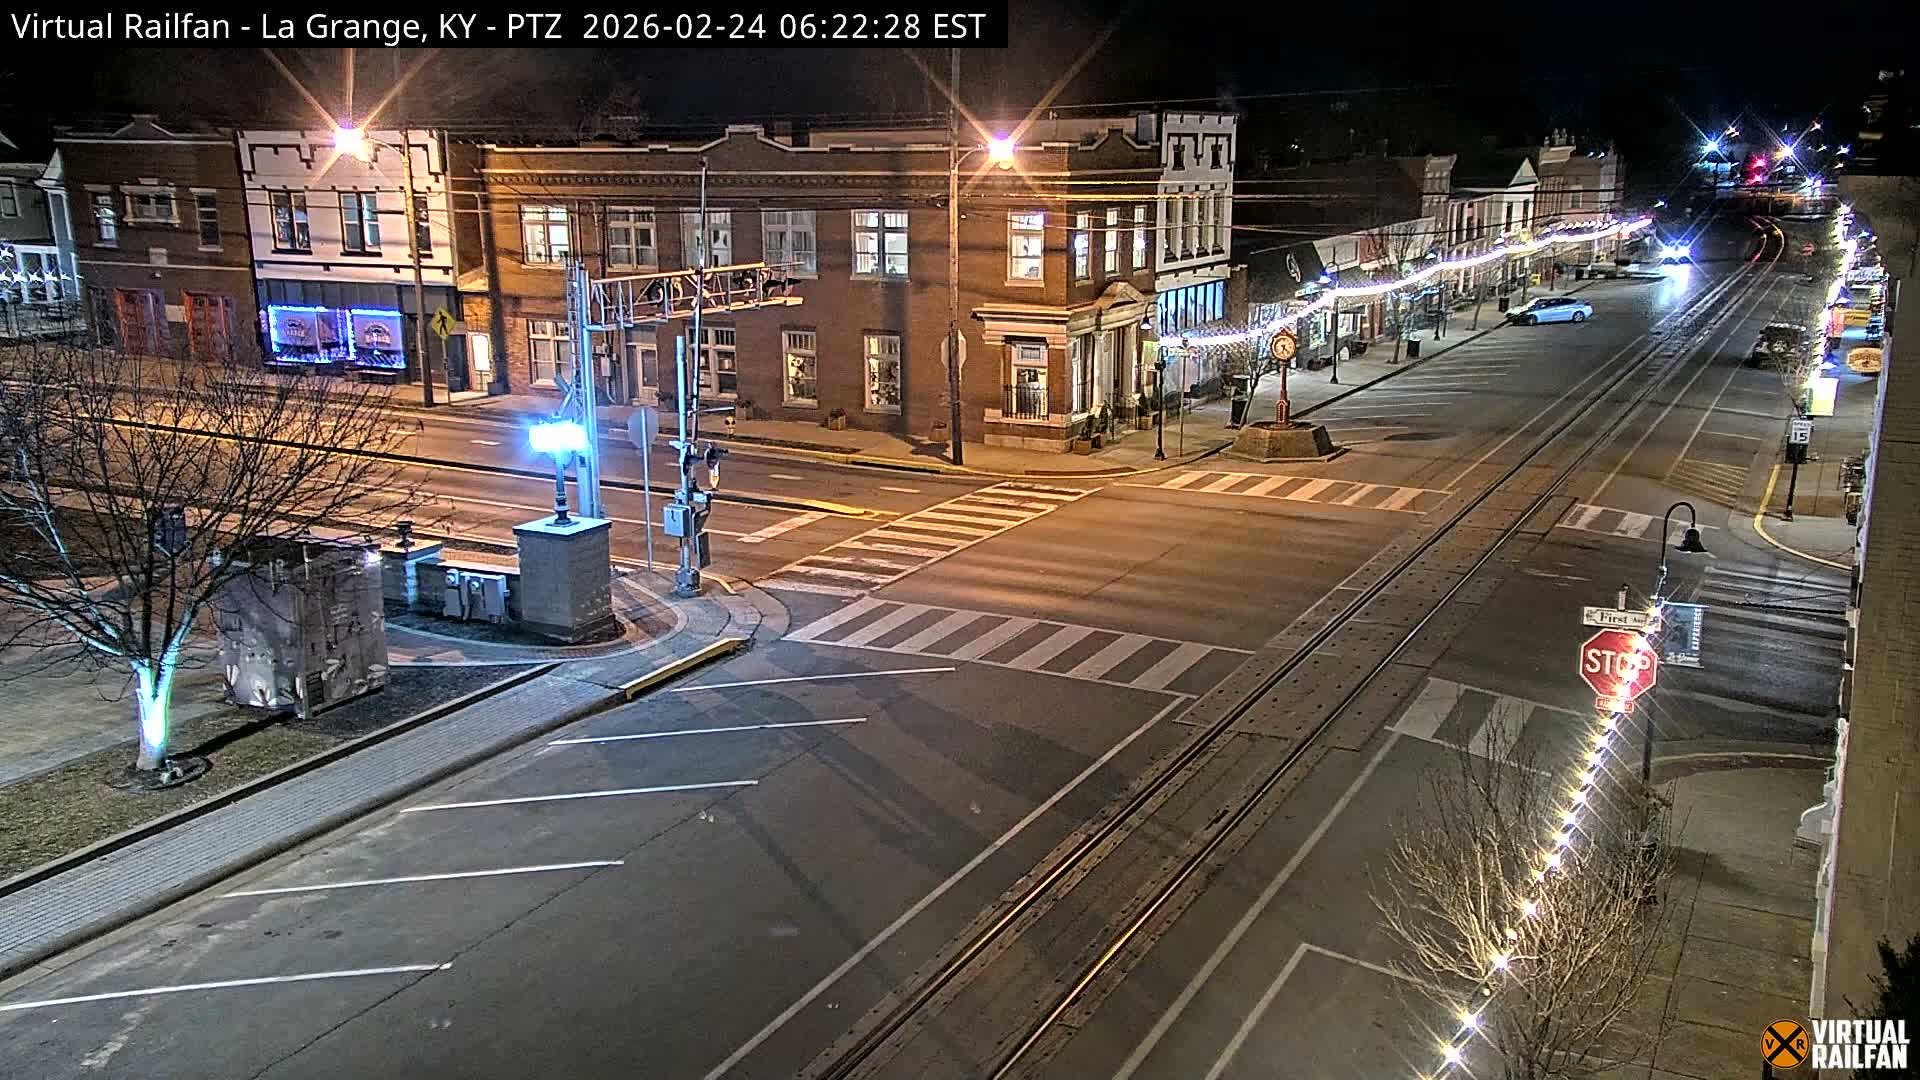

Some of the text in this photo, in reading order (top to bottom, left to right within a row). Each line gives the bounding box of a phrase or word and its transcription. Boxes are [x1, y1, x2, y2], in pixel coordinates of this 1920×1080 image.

[1794, 431, 1808, 442] 15
[1600, 611, 1628, 624] First
[1585, 648, 1651, 675] STOP
